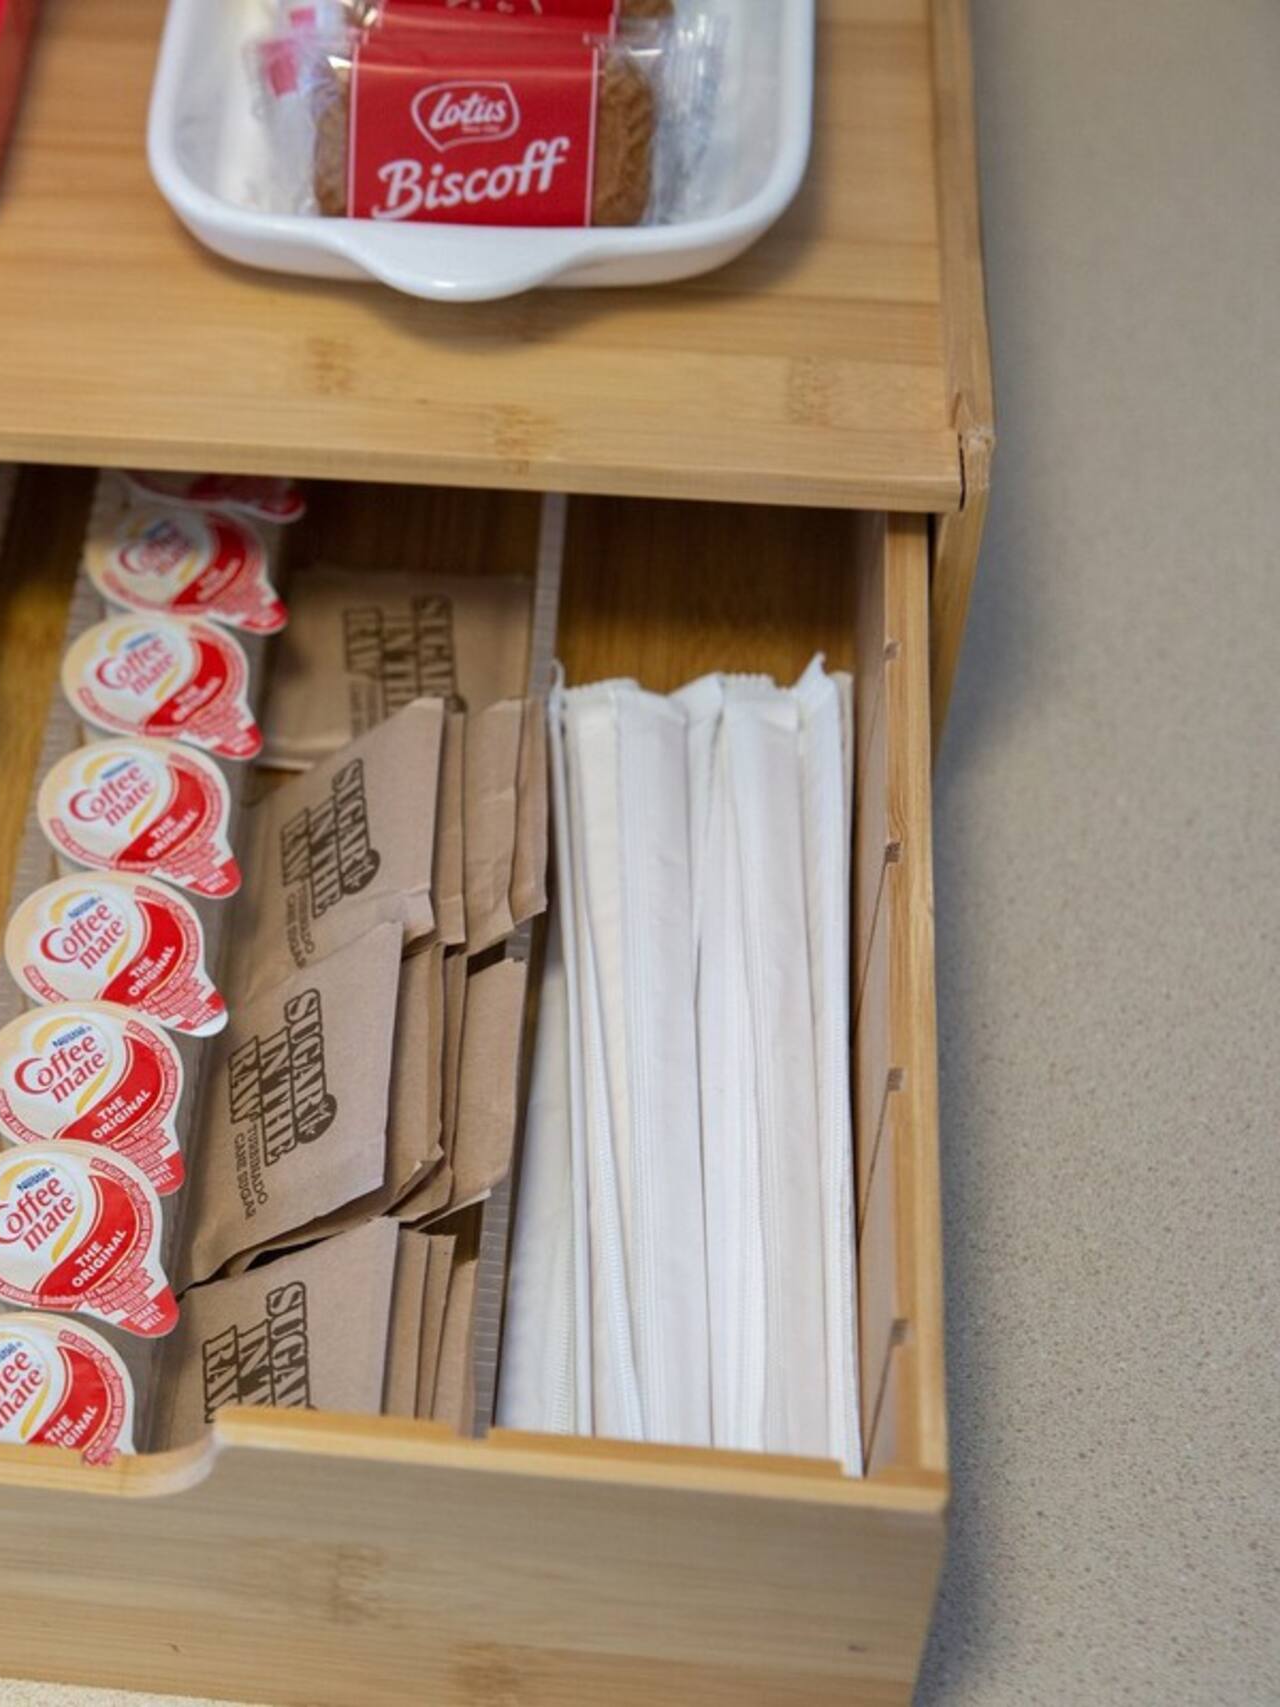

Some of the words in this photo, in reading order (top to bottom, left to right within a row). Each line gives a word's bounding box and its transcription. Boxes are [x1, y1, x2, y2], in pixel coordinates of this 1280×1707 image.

[429, 92, 507, 130] Lotus
[371, 137, 570, 220] Biscoff
[68, 766, 141, 822] Coffee
[105, 780, 152, 826] mate
[332, 759, 368, 874] SUGAR
[40, 904, 112, 963] Coffee
[79, 918, 125, 970] mate
[128, 946, 176, 996] ORIGINAL
[129, 954, 155, 979] THE
[14, 1035, 99, 1095] Coffee
[51, 1051, 106, 1103] mate
[229, 1036, 261, 1124] RAW
[260, 1028, 288, 1081] IN
[284, 989, 325, 1118] SUGAR
[91, 1089, 151, 1139] ORIGINAL
[98, 1095, 128, 1122] THE
[261, 1076, 295, 1166] THE
[23, 1196, 76, 1252] mate
[71, 1230, 127, 1288] ORIGINAL
[75, 1241, 103, 1268] THE
[238, 1319, 269, 1377] IN
[44, 1414, 74, 1442] THE
[57, 1405, 99, 1449] IGINAL
